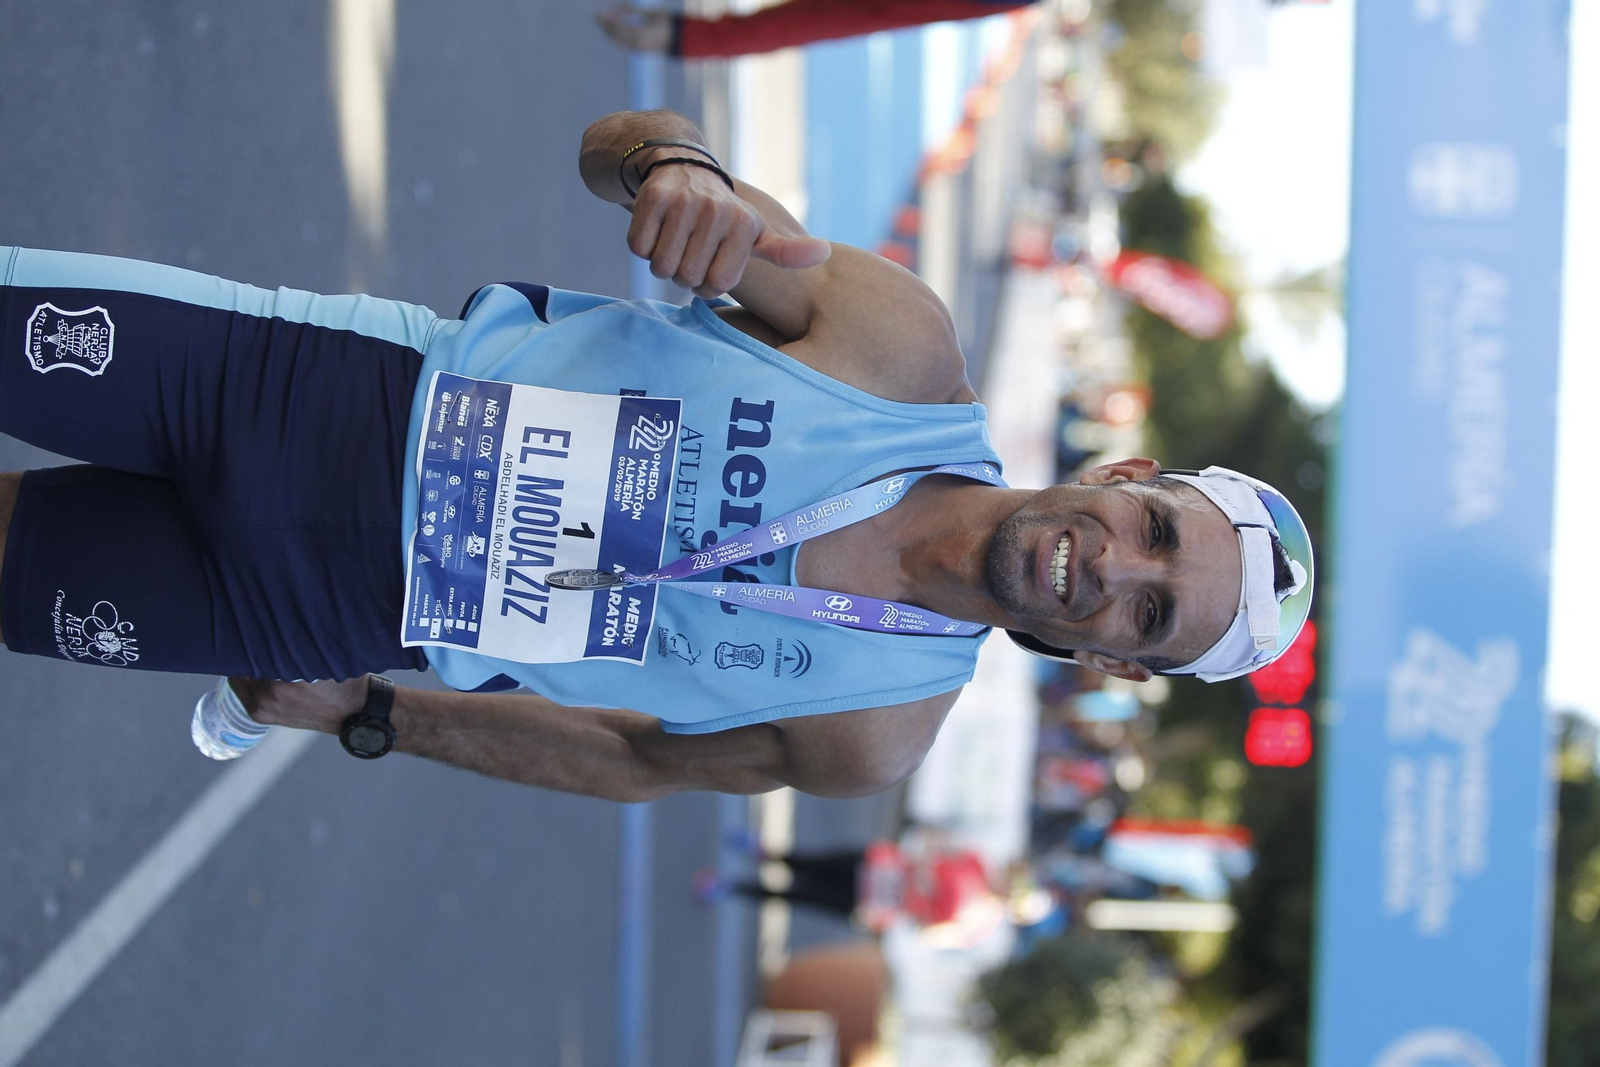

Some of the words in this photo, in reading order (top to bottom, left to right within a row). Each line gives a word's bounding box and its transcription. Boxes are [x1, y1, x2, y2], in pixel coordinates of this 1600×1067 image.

[33, 310, 47, 366] ATLETISMO
[90, 323, 100, 359] NERJA
[98, 327, 108, 358] CLUB
[436, 402, 449, 434] cajamar
[457, 395, 471, 427] Blanes
[482, 398, 498, 427] NEXA
[479, 434, 493, 462] CDX
[519, 426, 572, 464] EL
[497, 452, 514, 515] ABDELHADI
[613, 456, 625, 502] 03/02/2019
[619, 457, 636, 512] ALMERÍA
[631, 459, 649, 520] MARATÓN
[471, 485, 480, 506] CIUDAD
[475, 486, 488, 523] ALMERÍA
[495, 518, 505, 531] EL
[795, 497, 853, 527] ALMERÍA
[797, 518, 829, 535] CIUDAD
[562, 521, 596, 540] 1
[490, 533, 503, 580] MOUAZIZ
[501, 474, 565, 624] MOUAZIZ
[717, 542, 754, 558] MARATÓN
[719, 549, 752, 563] ALMERÍA
[422, 593, 430, 616] MASAJE
[458, 601, 466, 618] FRUTA
[736, 594, 767, 605] CIUDAD
[738, 587, 795, 602] ALMERÍA
[621, 597, 641, 646] MEDIO
[812, 609, 861, 624] HYUNDAI
[898, 623, 924, 631] ALMERÍA
[900, 617, 931, 627] MARATÓN
[56, 635, 65, 643] de
[65, 613, 89, 657] NERJA
[117, 621, 139, 662] CMD
